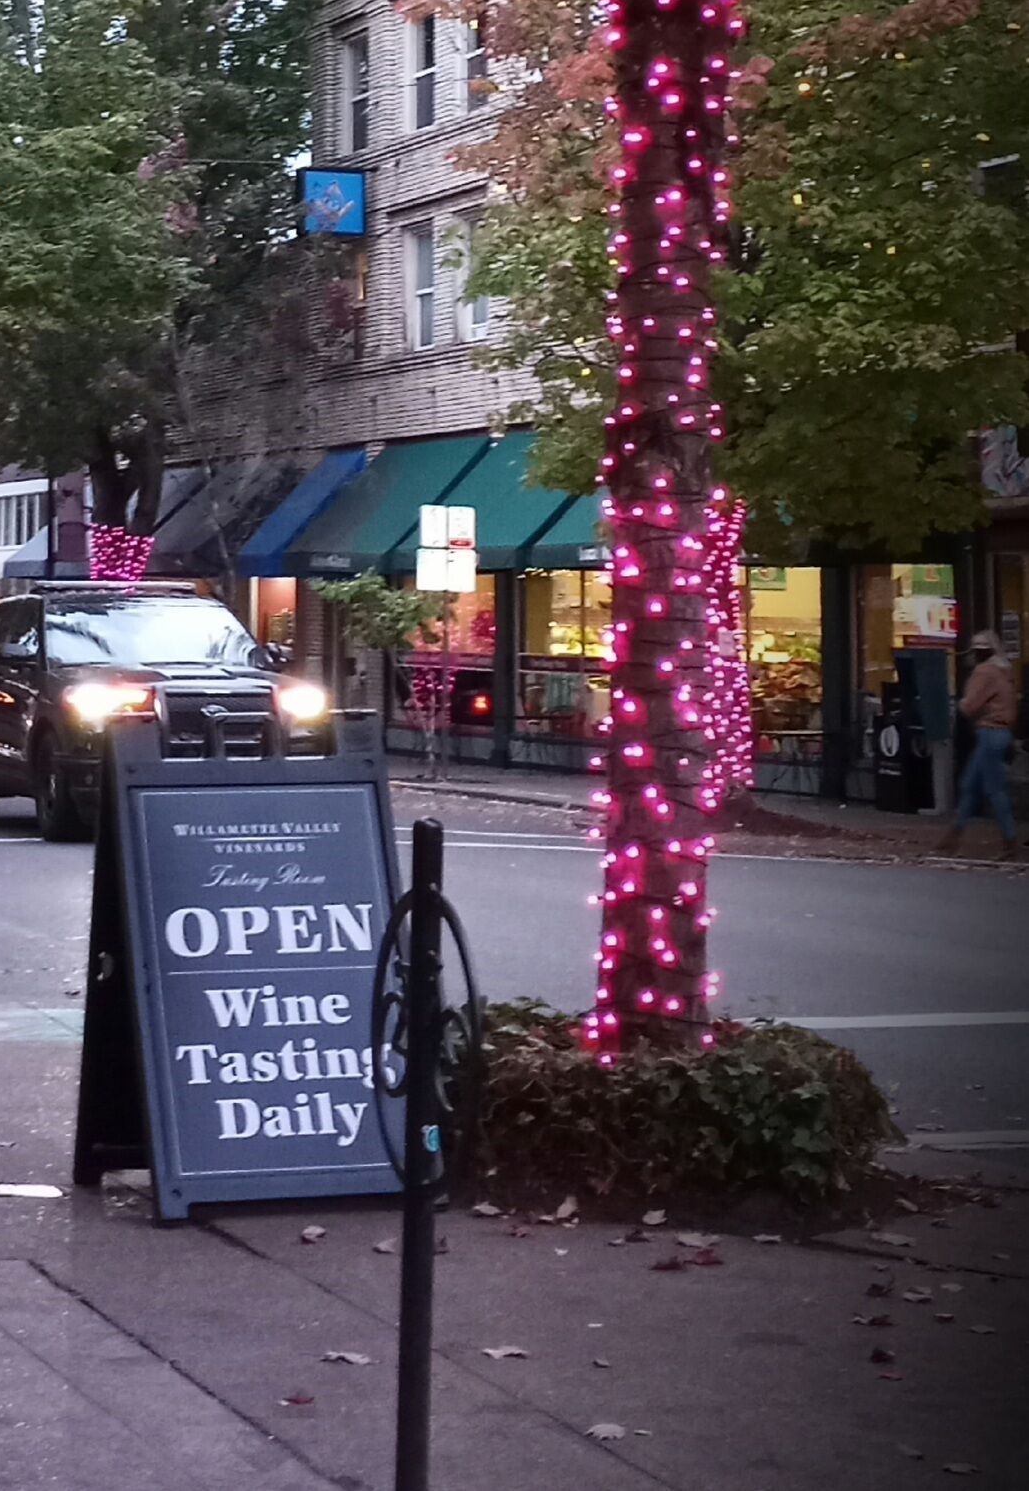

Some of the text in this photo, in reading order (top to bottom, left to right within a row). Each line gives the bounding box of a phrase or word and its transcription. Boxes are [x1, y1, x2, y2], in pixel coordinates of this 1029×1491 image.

[173, 822, 341, 836] WILLAMETTE VALLEY
[214, 842, 306, 853] VINEYARDS
[165, 904, 373, 957] OPEN
[204, 985, 352, 1027] Wine
[176, 1038, 397, 1089] Tasting
[215, 1092, 368, 1146] Daily
